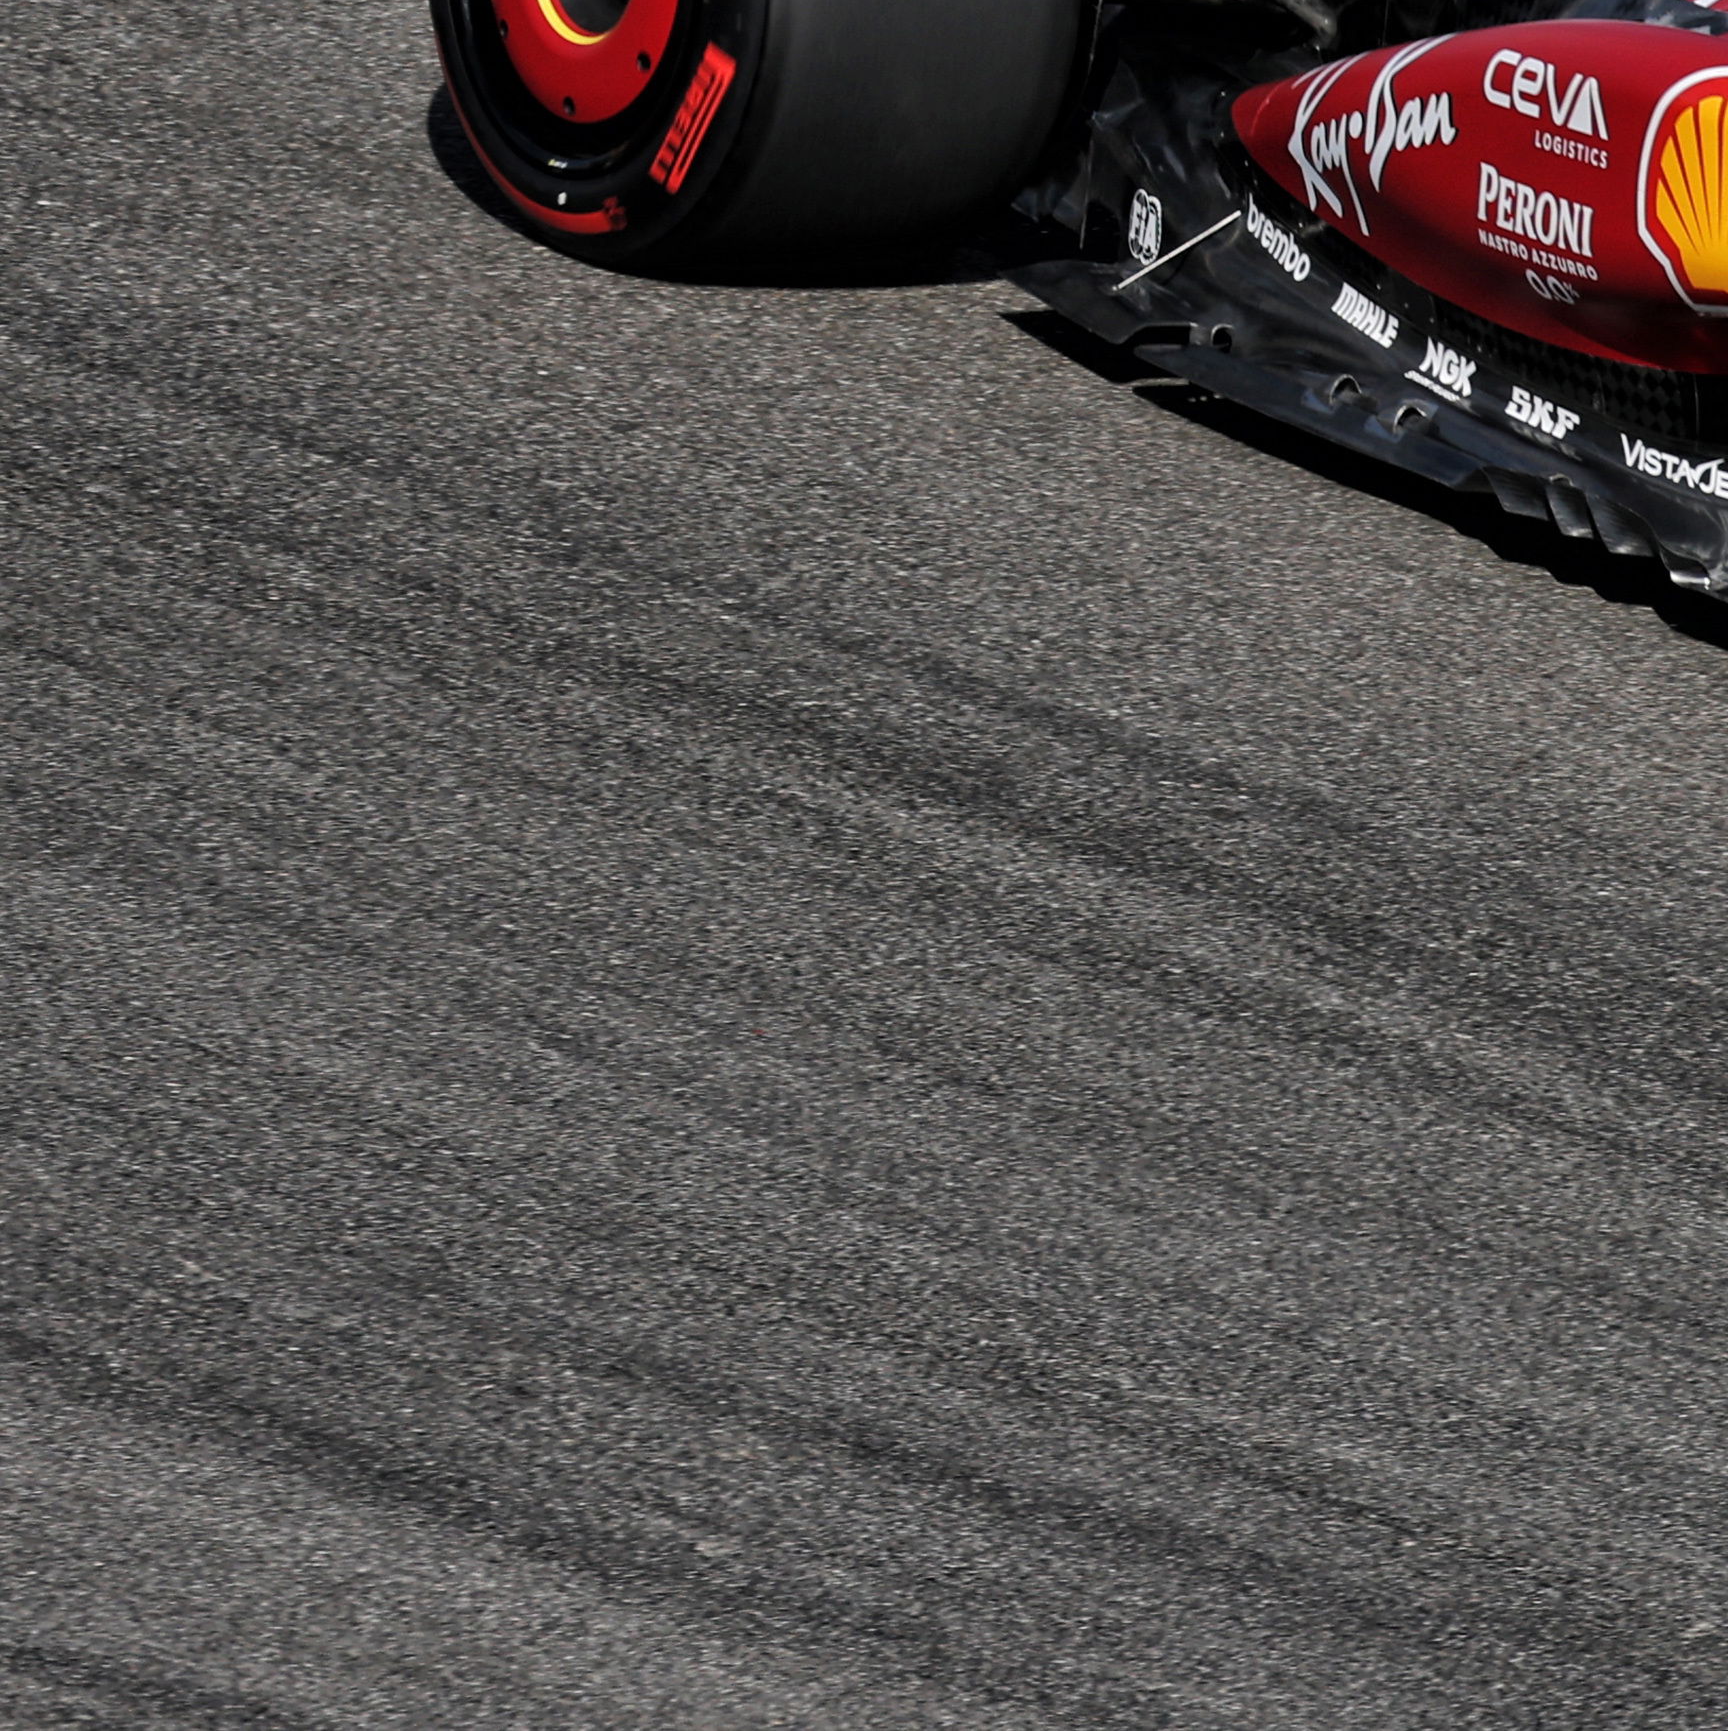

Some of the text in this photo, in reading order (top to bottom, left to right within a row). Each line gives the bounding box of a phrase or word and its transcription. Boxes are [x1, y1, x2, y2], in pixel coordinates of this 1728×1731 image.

[1534, 130, 1608, 169] LOGISTICS
[1247, 193, 1311, 282] brembo
[1477, 162, 1593, 258] PERONI
[1479, 228, 1598, 282] NASTRO AZZURRO
[1331, 282, 1399, 348] MAHLE
[1418, 336, 1477, 397] NGK
[1504, 385, 1581, 439] SKF
